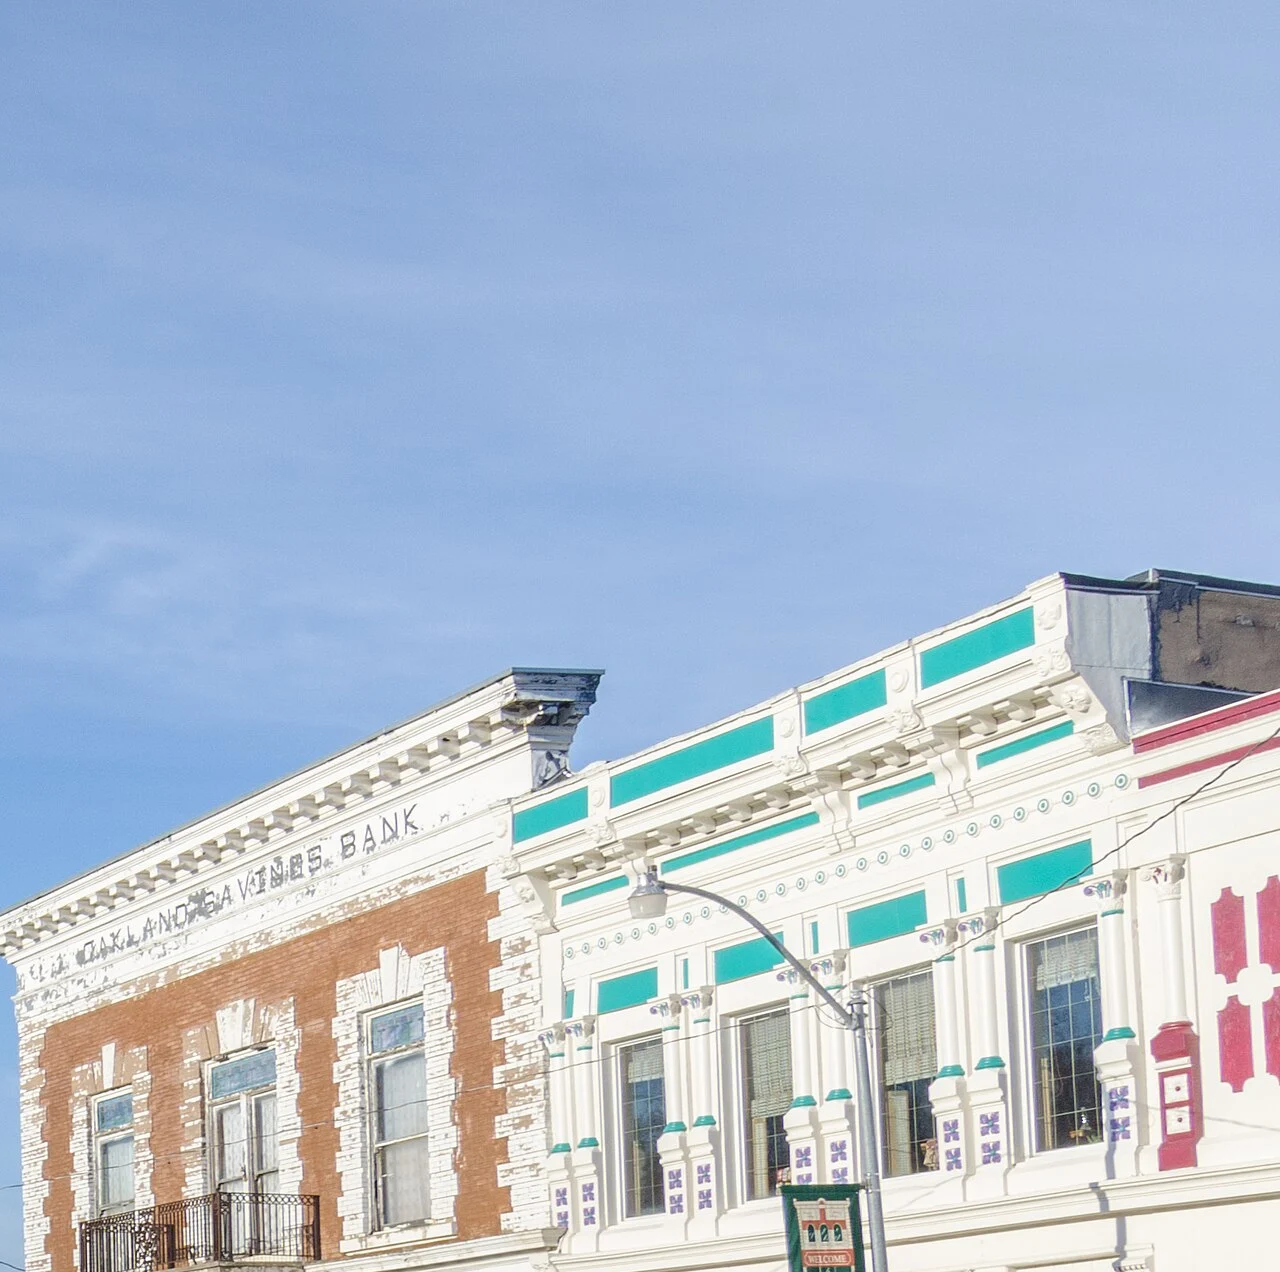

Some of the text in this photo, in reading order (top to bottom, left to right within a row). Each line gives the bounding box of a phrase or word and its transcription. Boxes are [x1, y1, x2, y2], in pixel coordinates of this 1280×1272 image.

[78, 803, 419, 966] OAKLAND SAVINGS BANK
[807, 1254, 847, 1264] WELCOME
